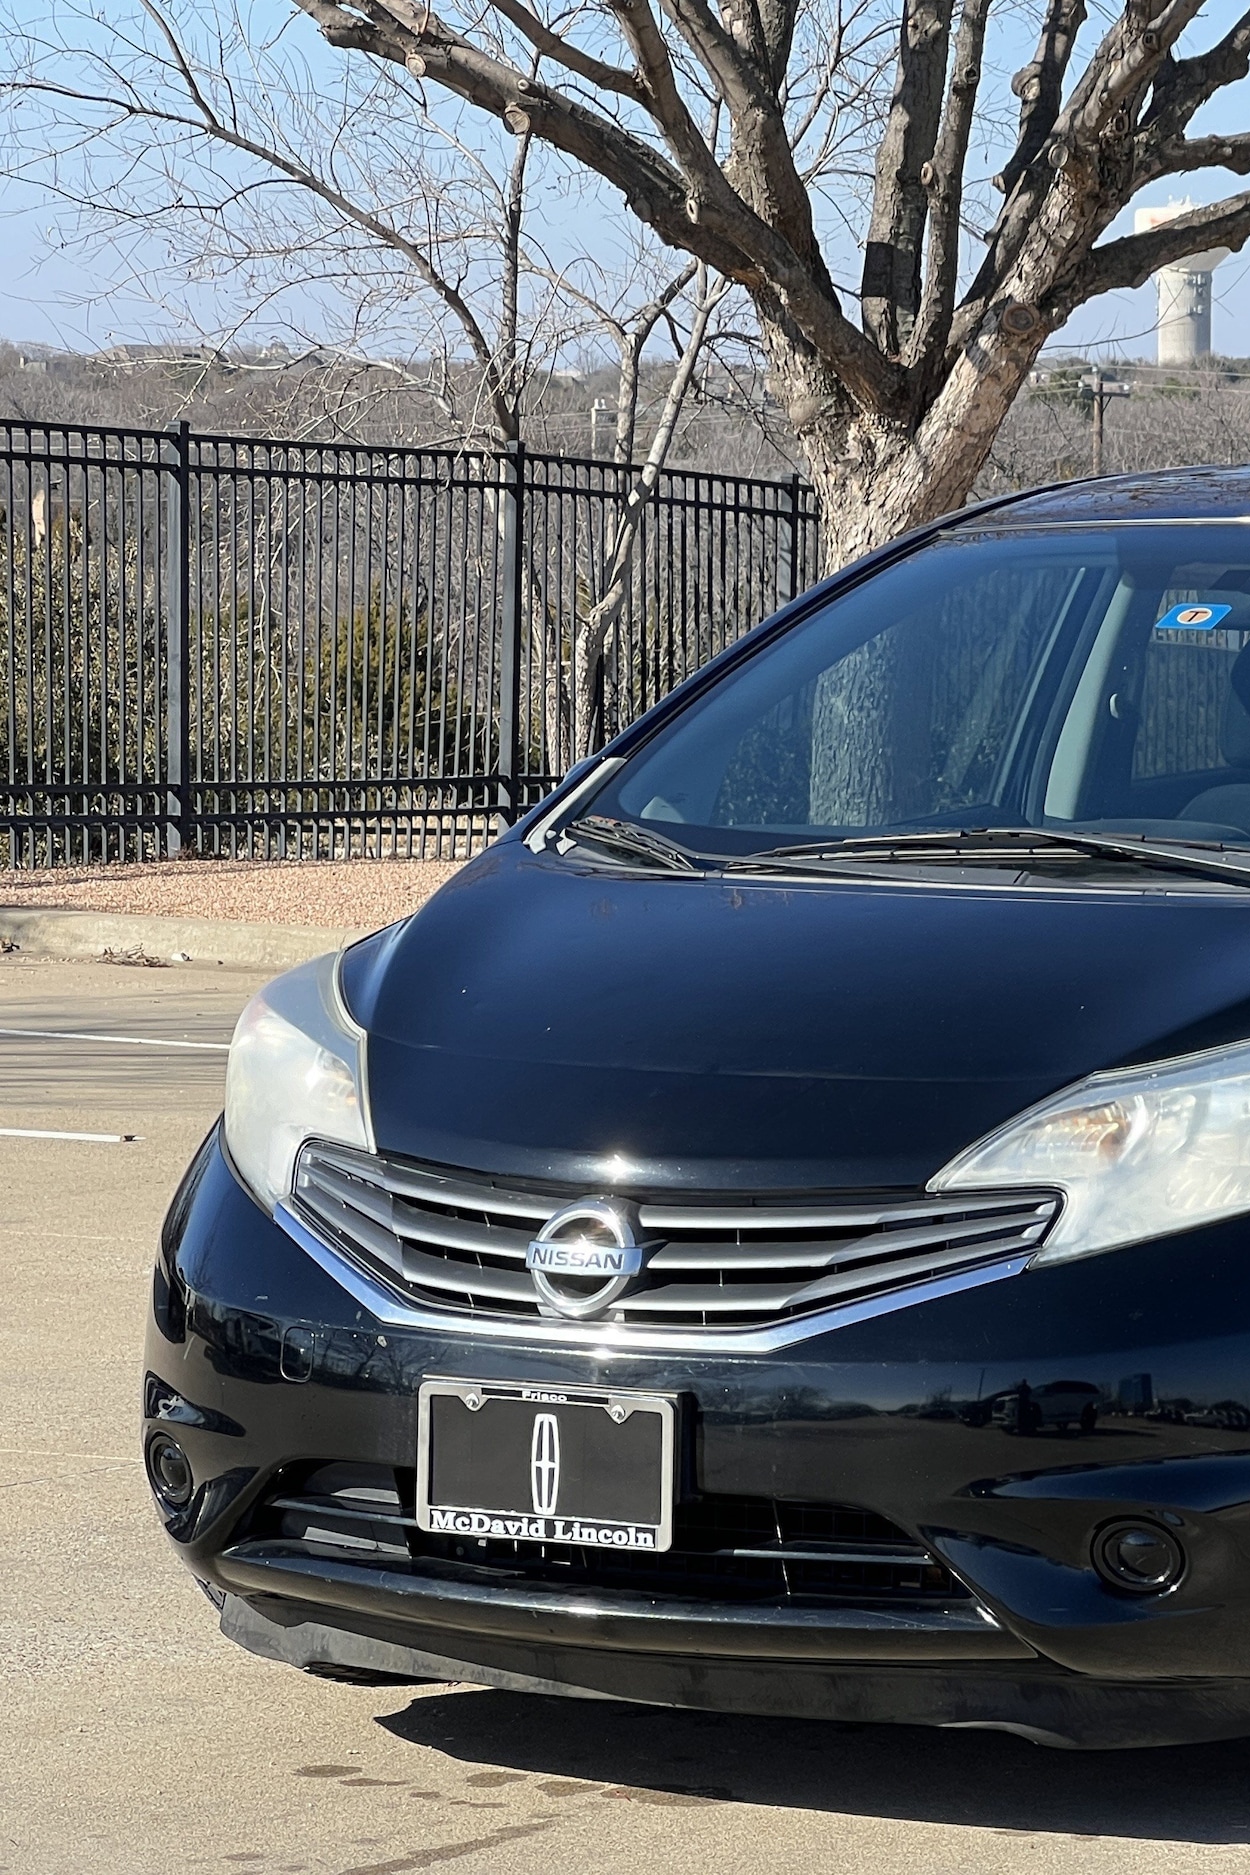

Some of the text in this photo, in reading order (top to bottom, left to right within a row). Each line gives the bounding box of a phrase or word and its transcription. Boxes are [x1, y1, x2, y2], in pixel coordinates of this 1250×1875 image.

[532, 1247, 623, 1270] NISSAN
[430, 1510, 655, 1548] McDavid Lincoln
